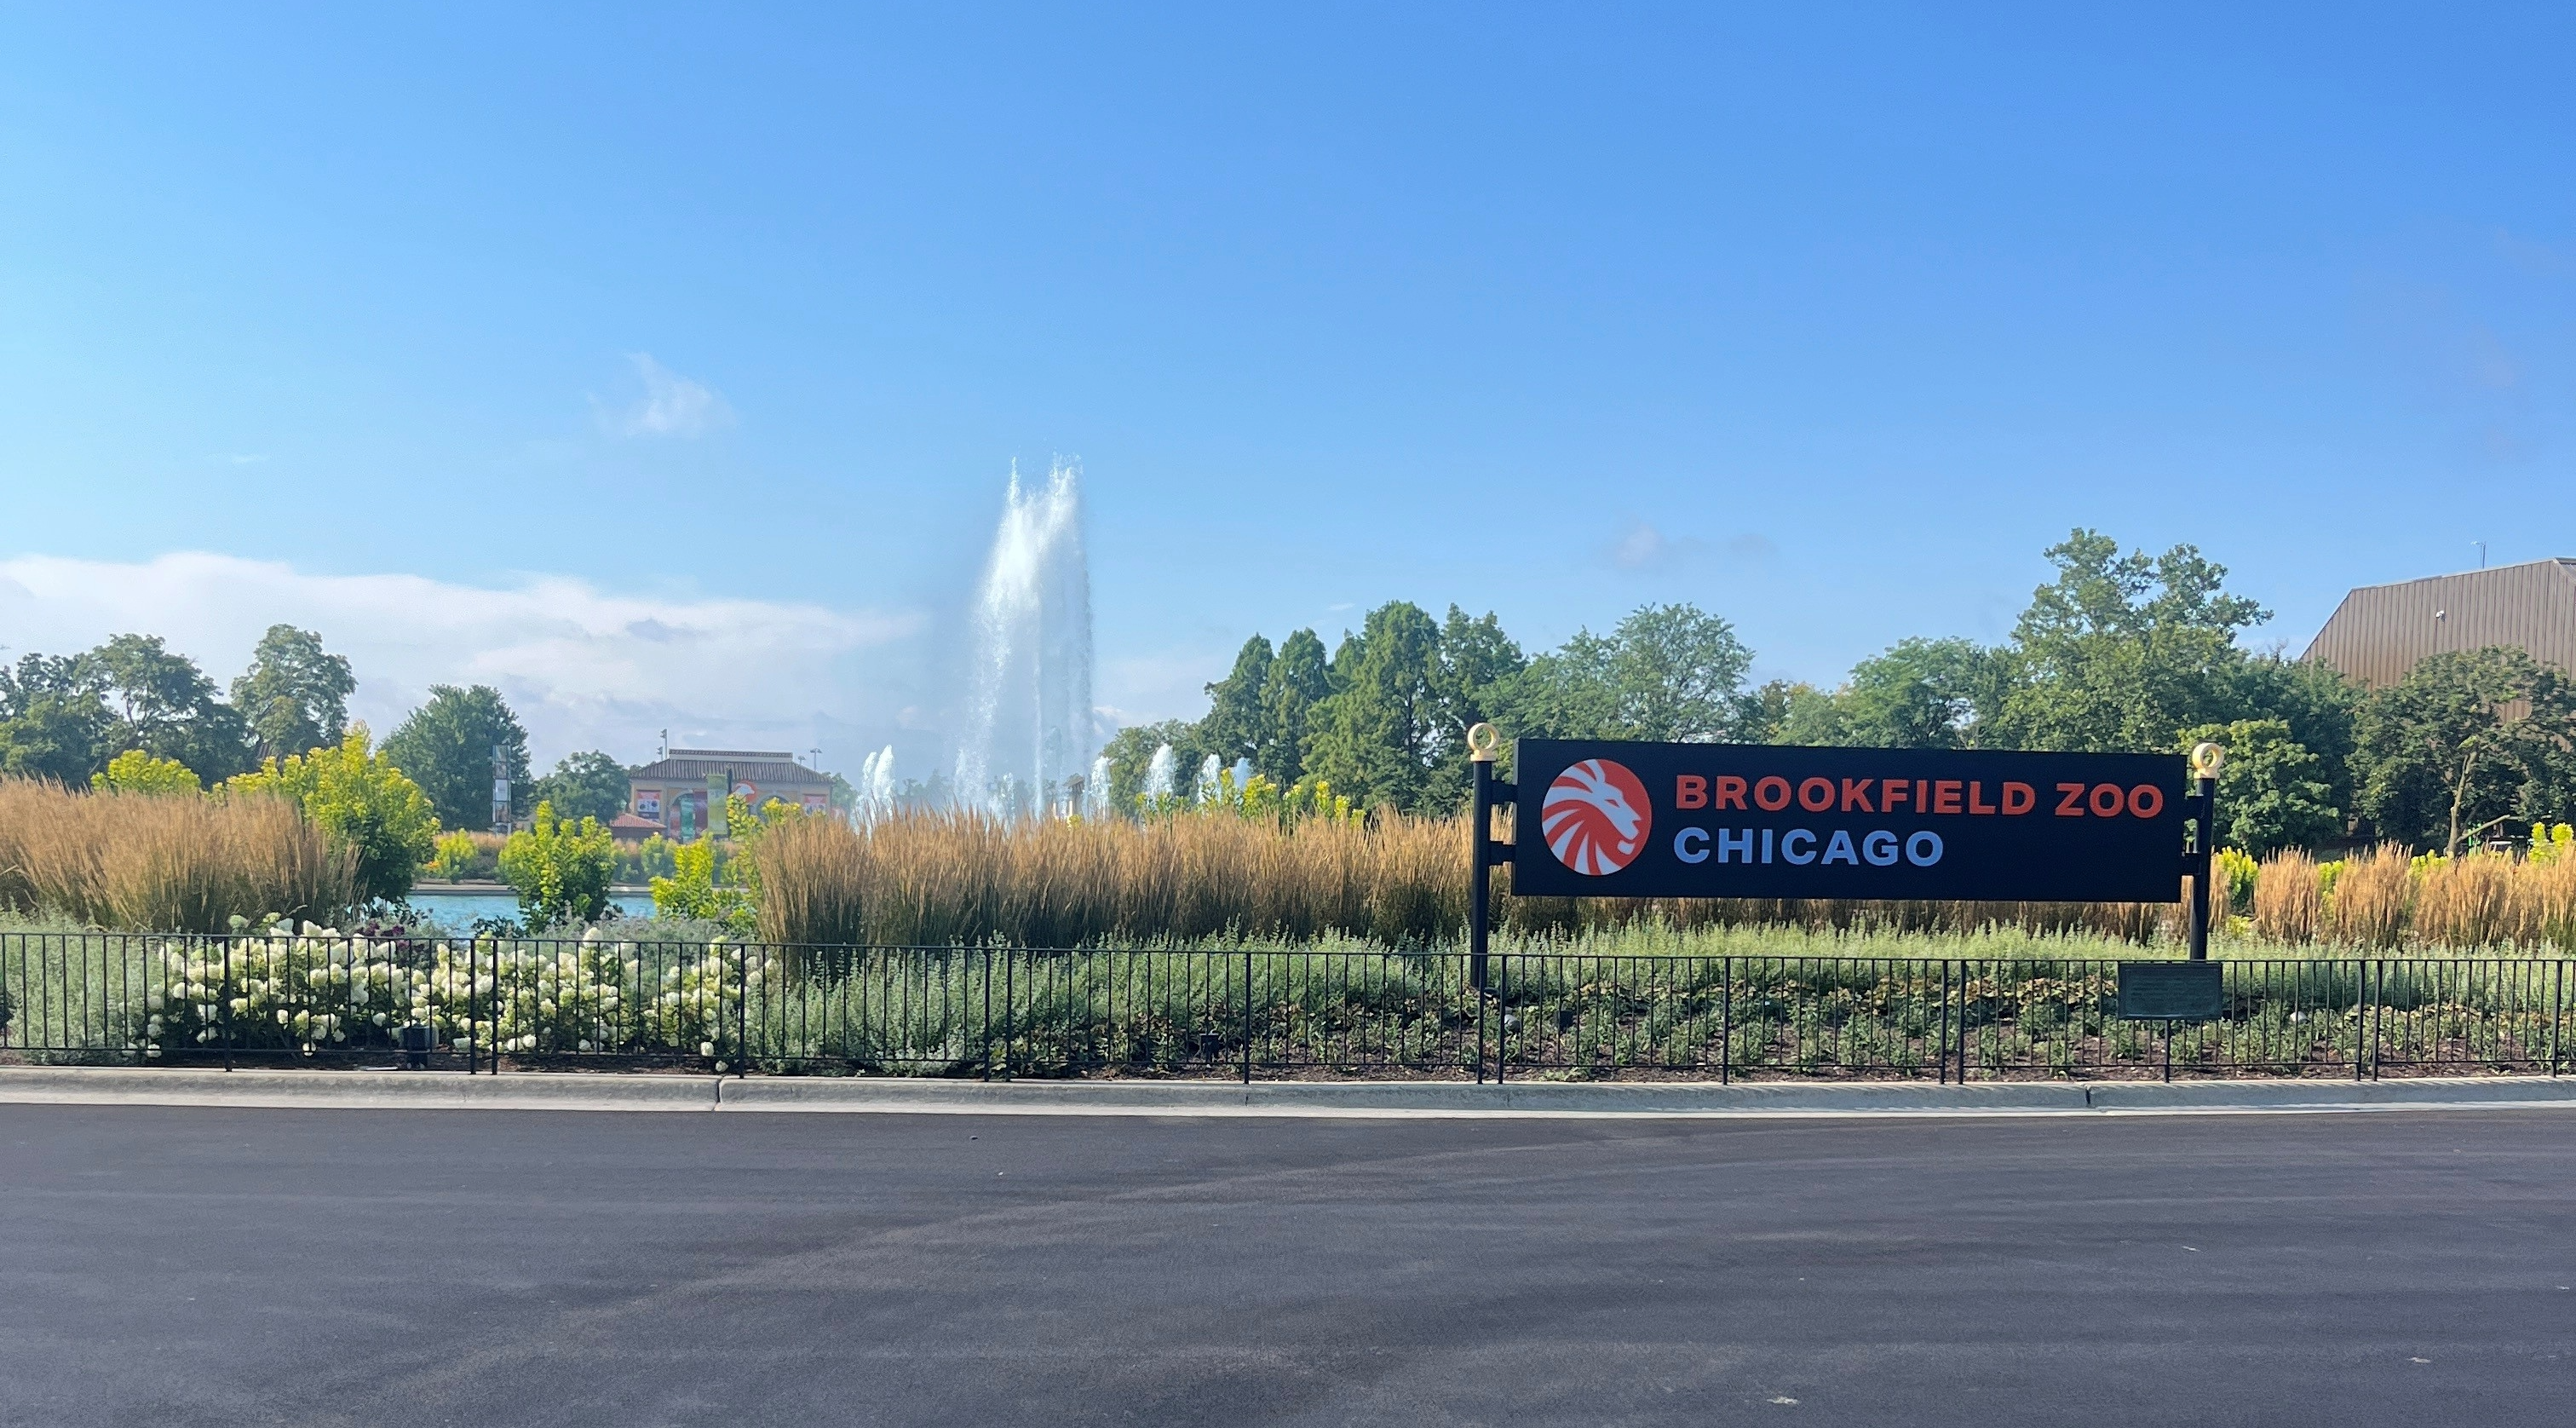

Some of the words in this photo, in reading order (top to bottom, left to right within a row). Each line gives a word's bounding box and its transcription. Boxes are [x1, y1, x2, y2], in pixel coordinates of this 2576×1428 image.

[1676, 775, 2036, 815] BROOKFIELD
[2056, 782, 2164, 818] ZOO
[1673, 826, 1944, 867] CHICAGO
